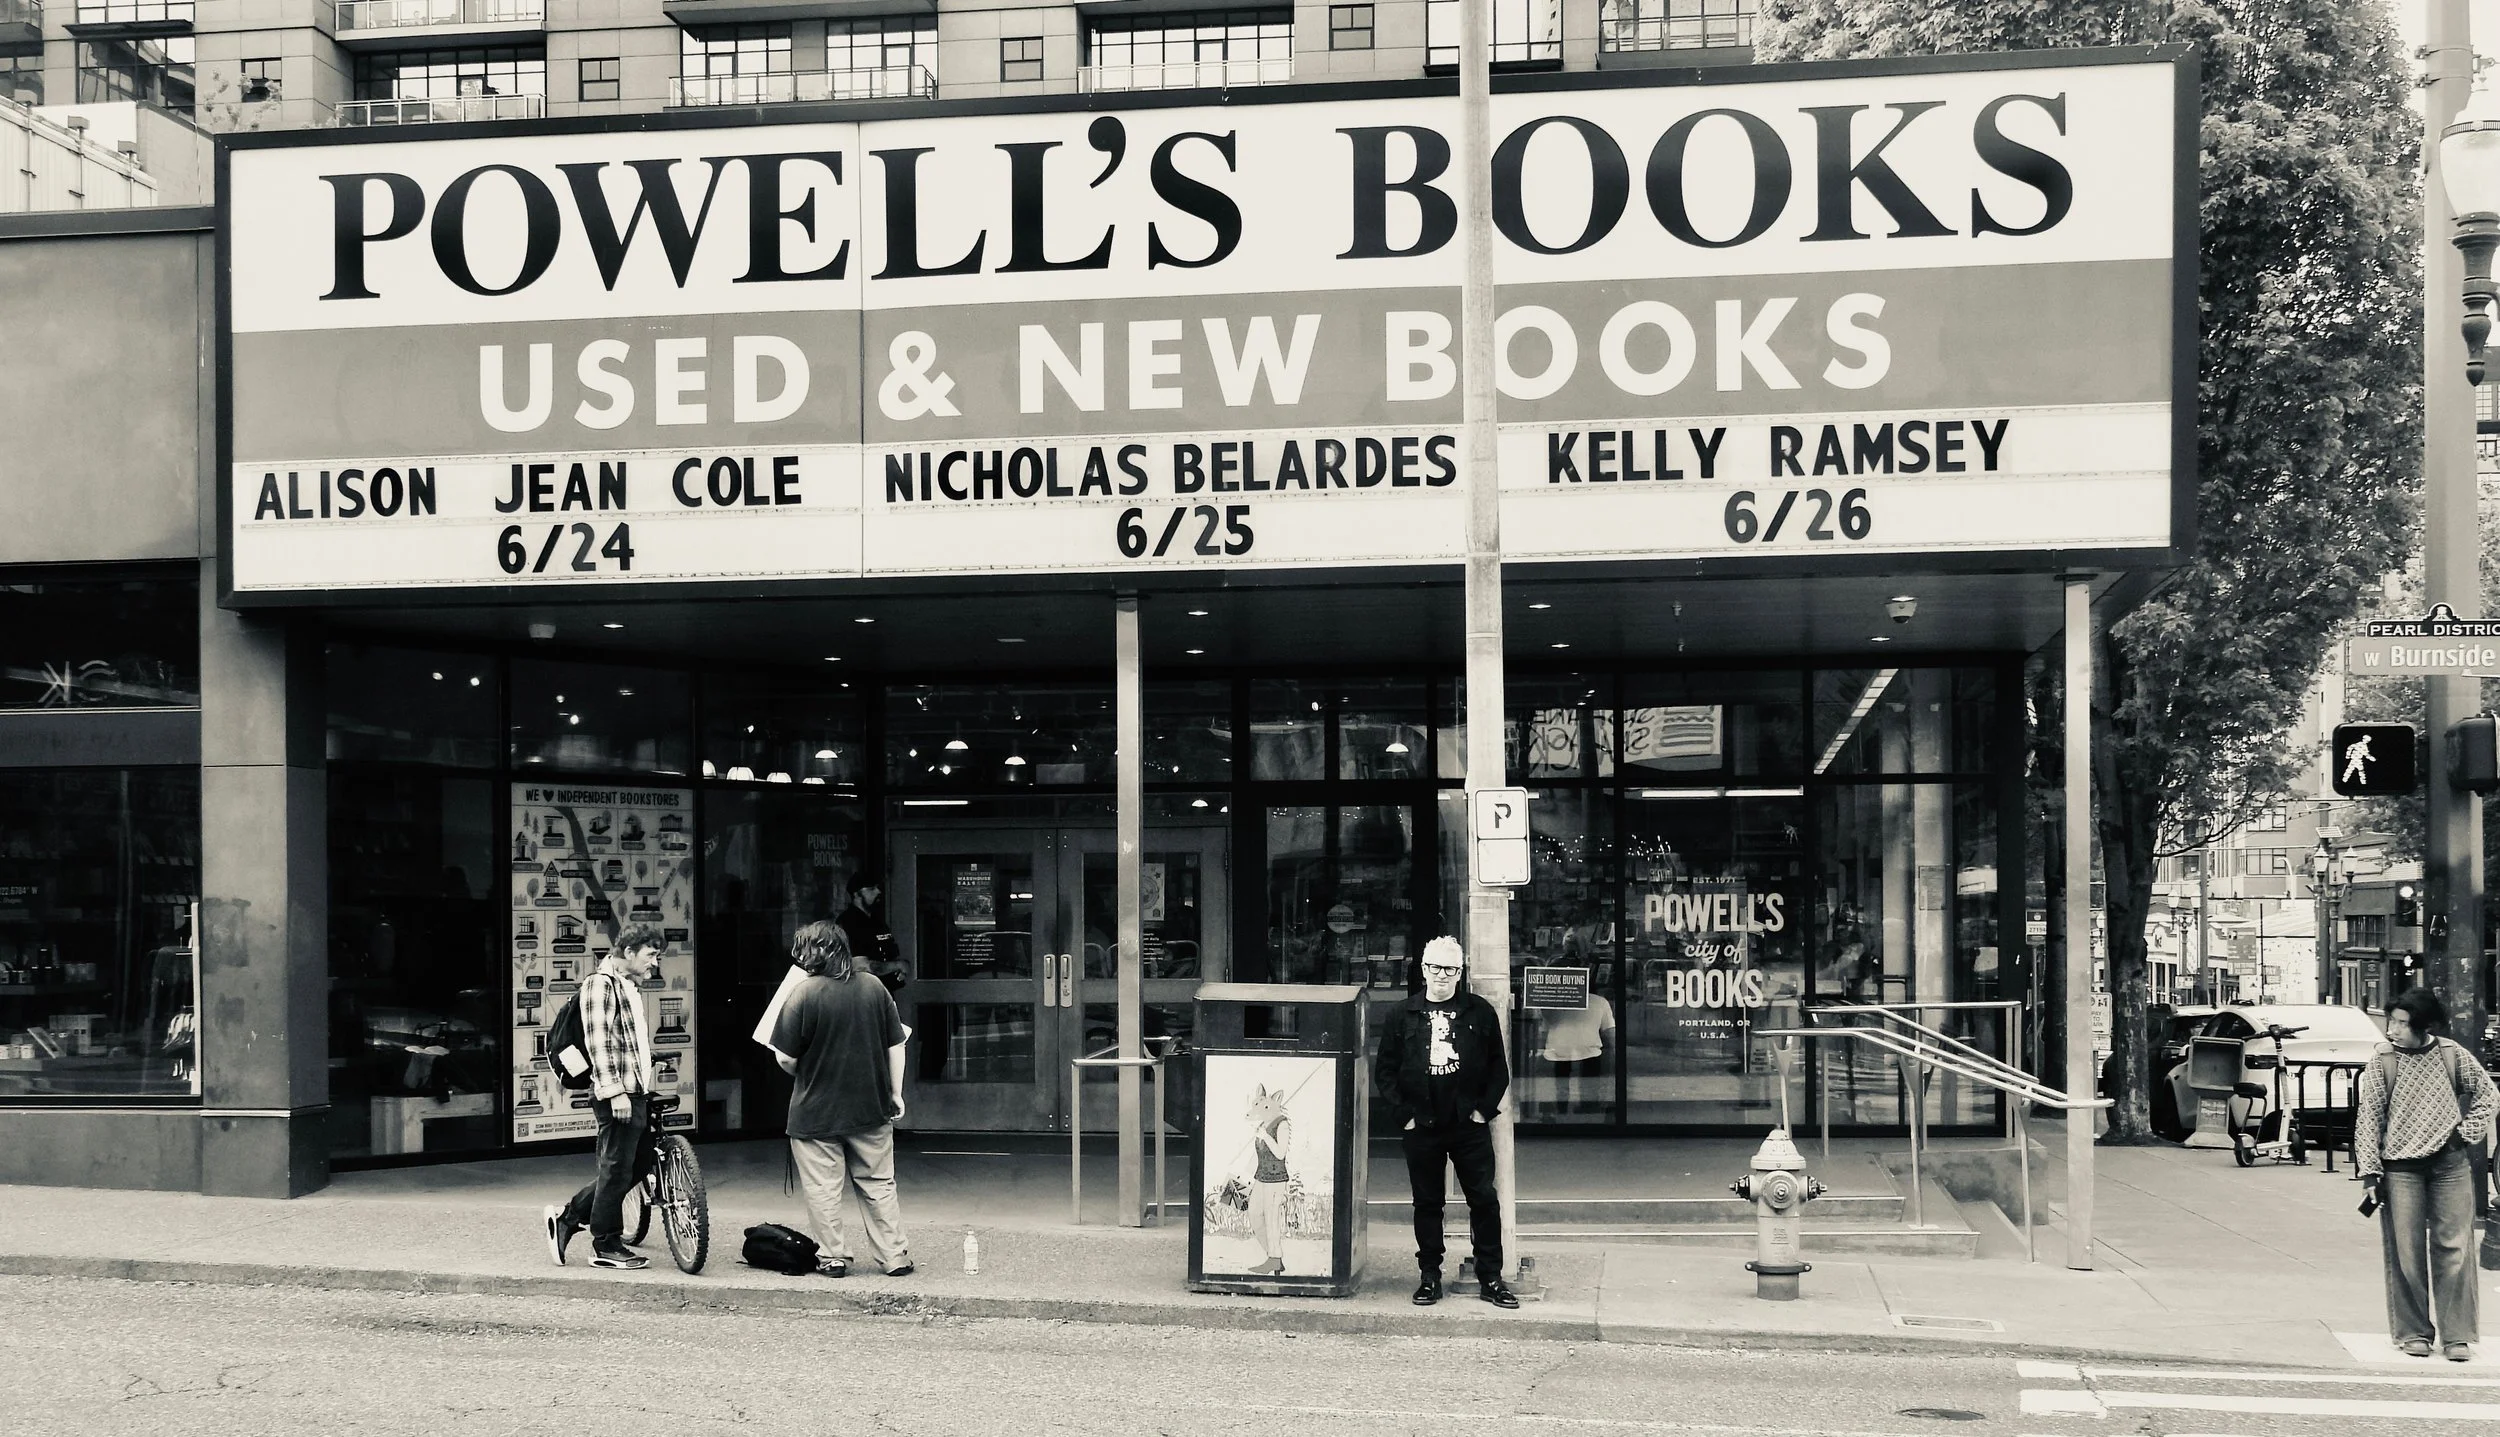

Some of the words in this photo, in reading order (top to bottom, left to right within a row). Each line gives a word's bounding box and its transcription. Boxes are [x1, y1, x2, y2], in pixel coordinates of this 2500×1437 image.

[319, 116, 1242, 300] POWELL'S
[1336, 92, 2073, 259] BOOKS
[480, 336, 809, 432] USED
[879, 331, 961, 420] &
[1020, 314, 1321, 413] NEW
[1386, 293, 1890, 401] BOOKS
[886, 445, 1148, 502] NICHOLAS
[1174, 435, 1456, 493] BELARDES
[1549, 428, 1726, 483] KELLY
[1771, 419, 2009, 476] RAMSEY
[255, 468, 436, 520] ALISON
[496, 462, 626, 513] JEAN
[673, 456, 801, 507] COLE
[1117, 505, 1253, 558] 6/25
[1725, 488, 1871, 543] 6/26
[498, 522, 634, 574] 6/24
[2370, 624, 2428, 636] PEARL
[2391, 643, 2496, 667] Burnside
[525, 789, 540, 801] WE
[557, 790, 617, 805] INDEPENDENT
[619, 792, 680, 806] BOOKSTORES
[1715, 876, 1736, 884] 1971
[1644, 892, 1785, 933] POWELL'S
[1684, 939, 1720, 965] city
[1723, 938, 1744, 965] of
[1528, 974, 1544, 985] USED
[1545, 974, 1562, 985] BOOK
[1562, 974, 1585, 985] BUYING
[1666, 968, 1764, 1008] BOOKS
[1679, 1019, 1734, 1028] PORTLAND,
[1736, 1019, 1751, 1027] OR
[1700, 1031, 1730, 1039] U.S.A.
